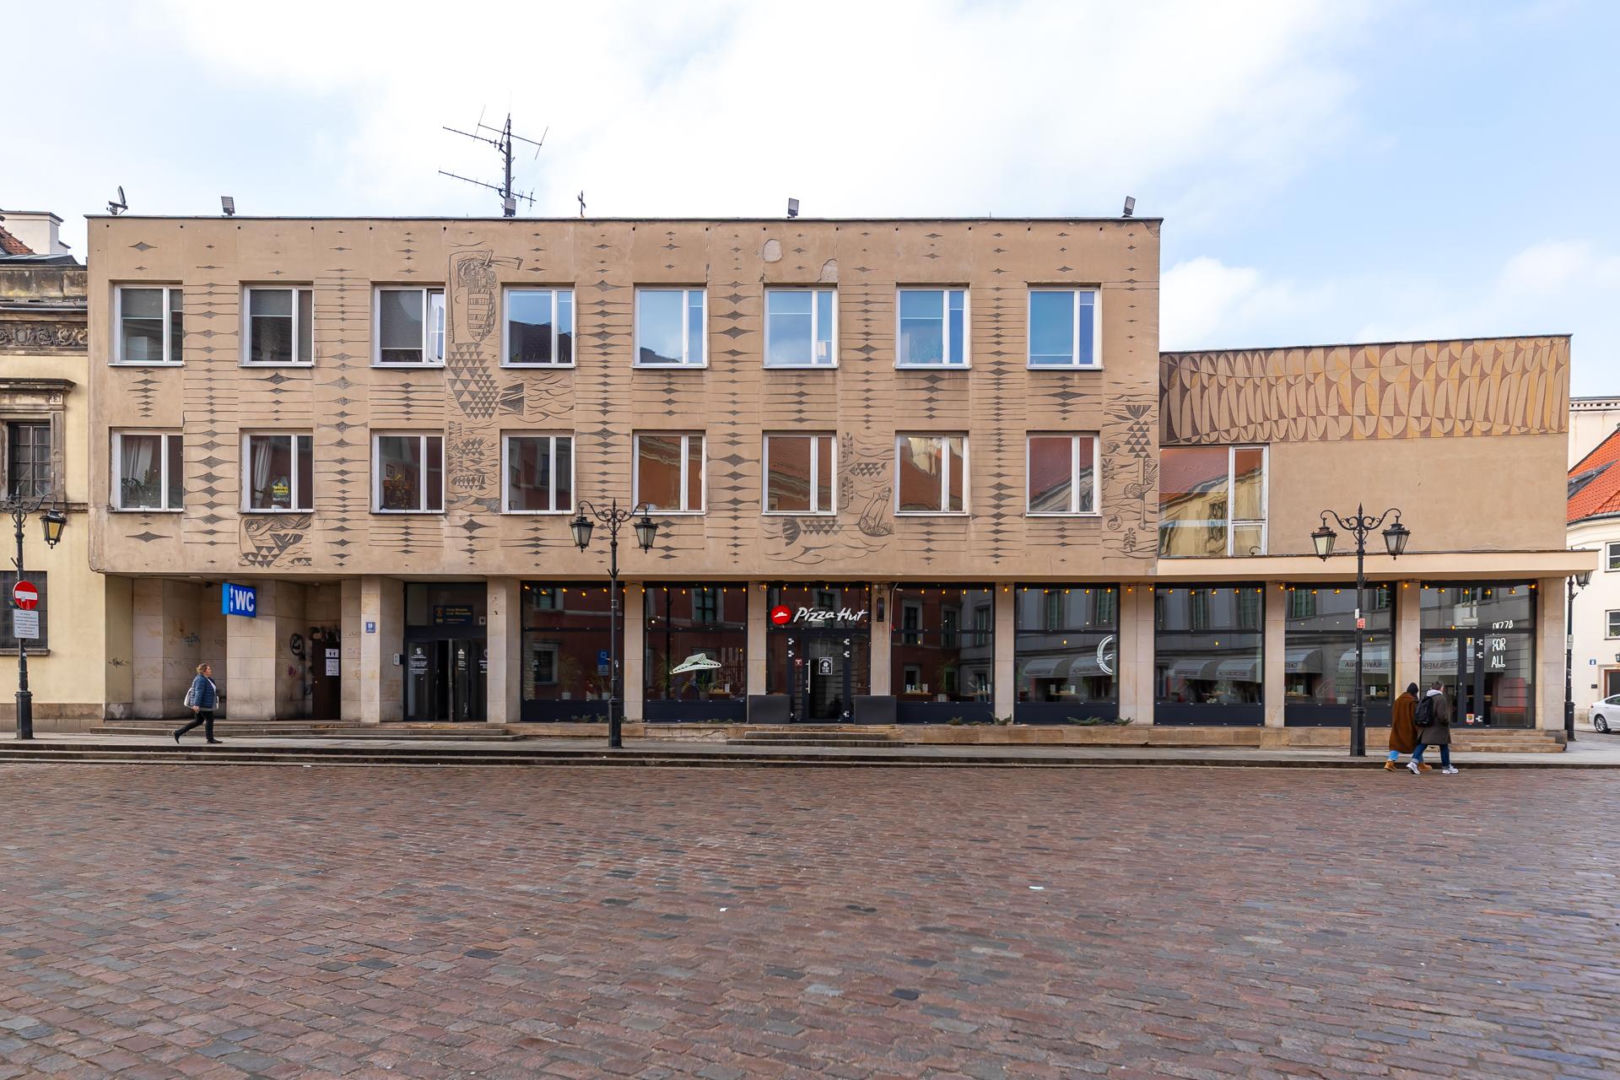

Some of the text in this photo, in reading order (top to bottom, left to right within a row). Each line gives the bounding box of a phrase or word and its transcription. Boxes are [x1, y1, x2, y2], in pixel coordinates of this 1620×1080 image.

[235, 589, 254, 612] WC
[793, 607, 869, 623] Pizza Hut
[1492, 637, 1506, 652] FOR
[1491, 655, 1506, 668] ALL
